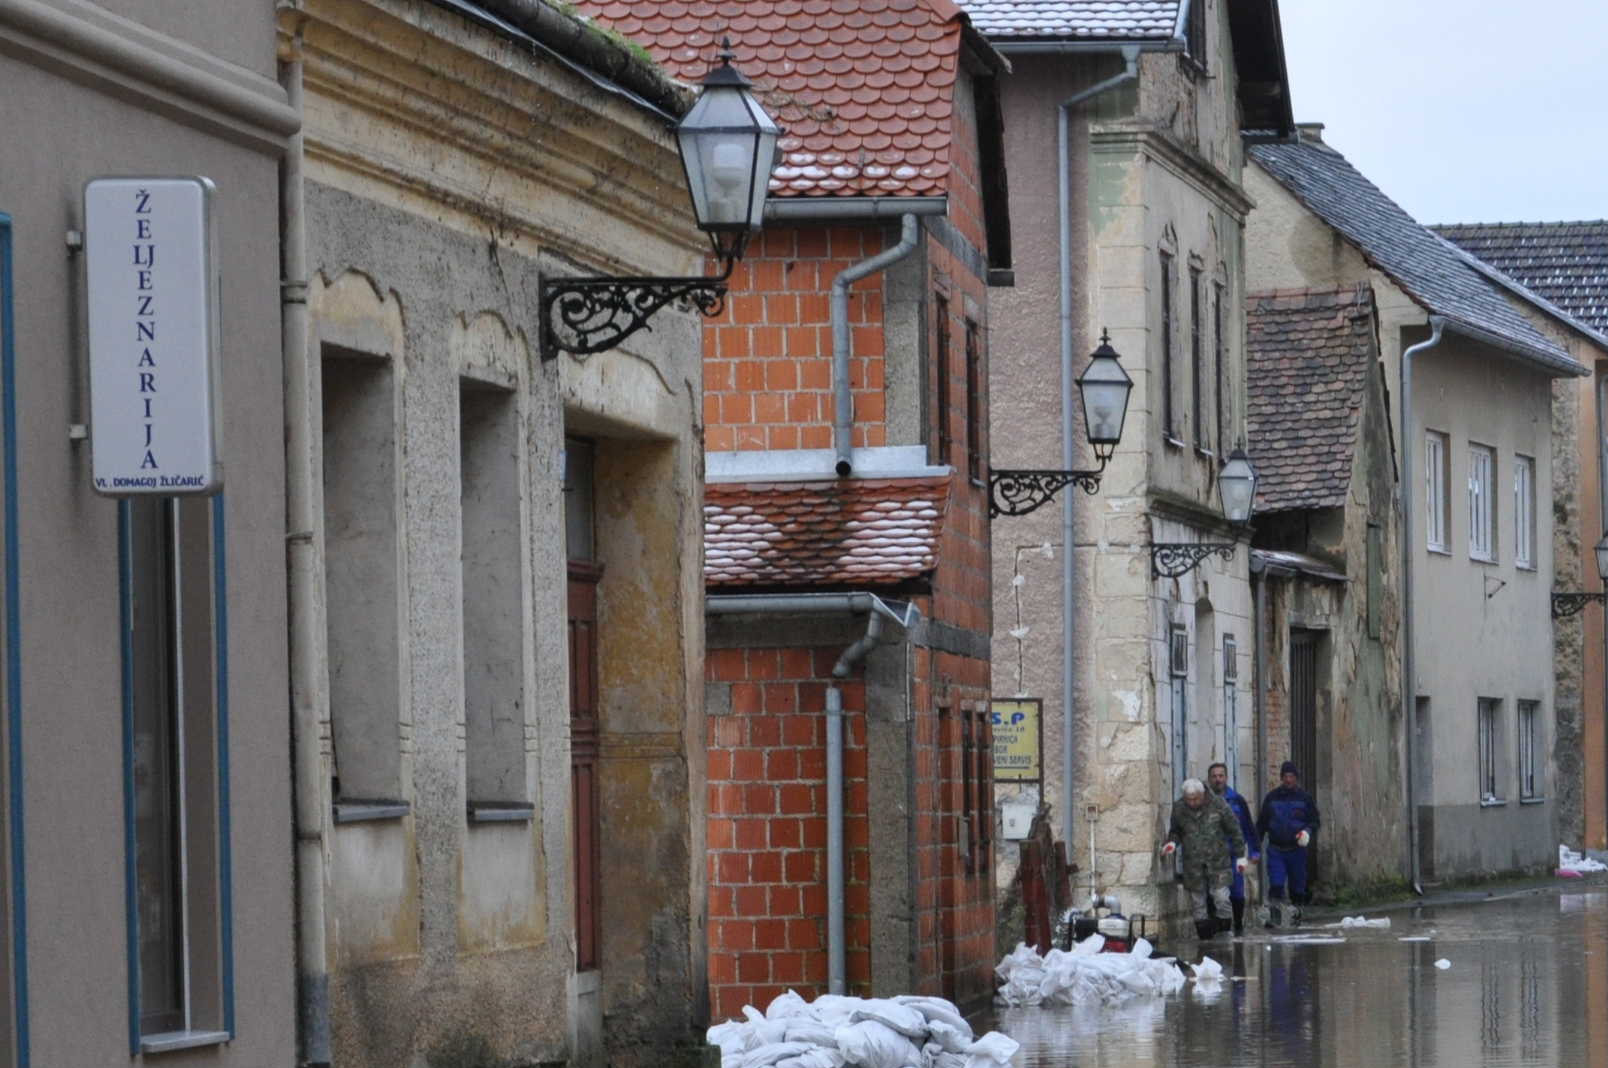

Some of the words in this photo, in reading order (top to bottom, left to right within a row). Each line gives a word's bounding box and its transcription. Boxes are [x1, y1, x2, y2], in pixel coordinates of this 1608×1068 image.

[132, 189, 158, 469] ŽELJEZNARIJA
[113, 477, 157, 488] DOMAGOJ
[160, 474, 204, 487] ŽLIČARIĆ
[1009, 755, 1032, 765] SERVIS
